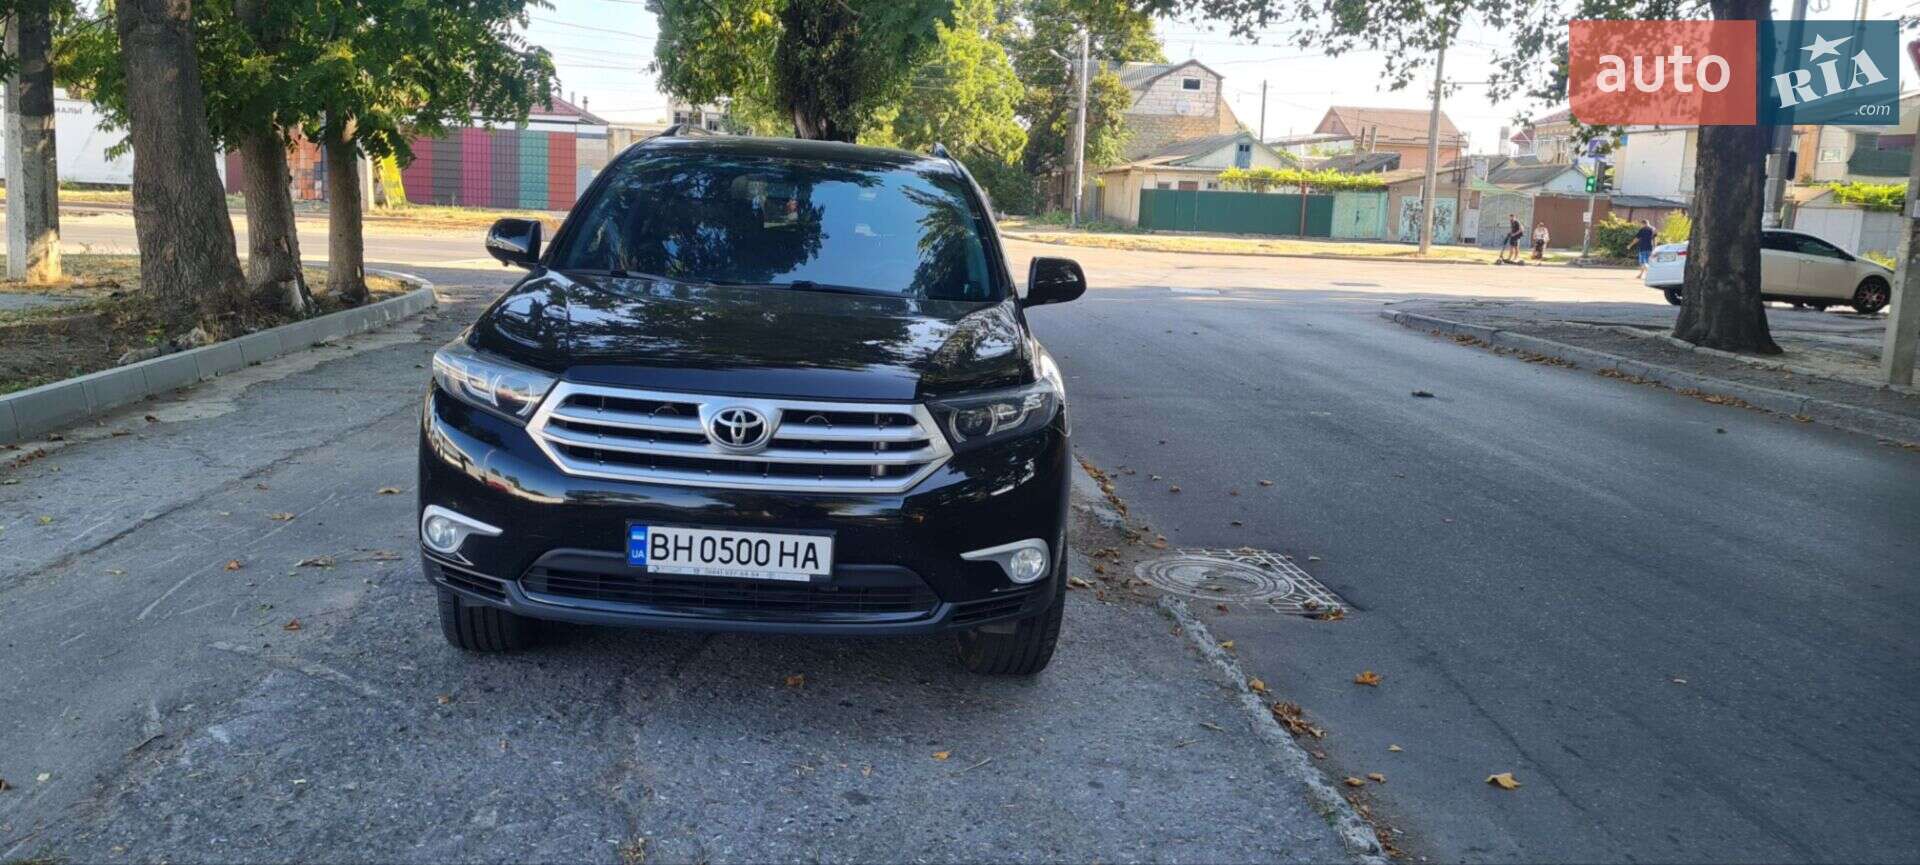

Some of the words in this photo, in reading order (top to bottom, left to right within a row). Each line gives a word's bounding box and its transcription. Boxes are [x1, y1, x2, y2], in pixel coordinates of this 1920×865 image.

[631, 549, 645, 560] UA
[649, 533, 694, 562] BH
[700, 536, 771, 567] 0500
[778, 540, 820, 570] HA
